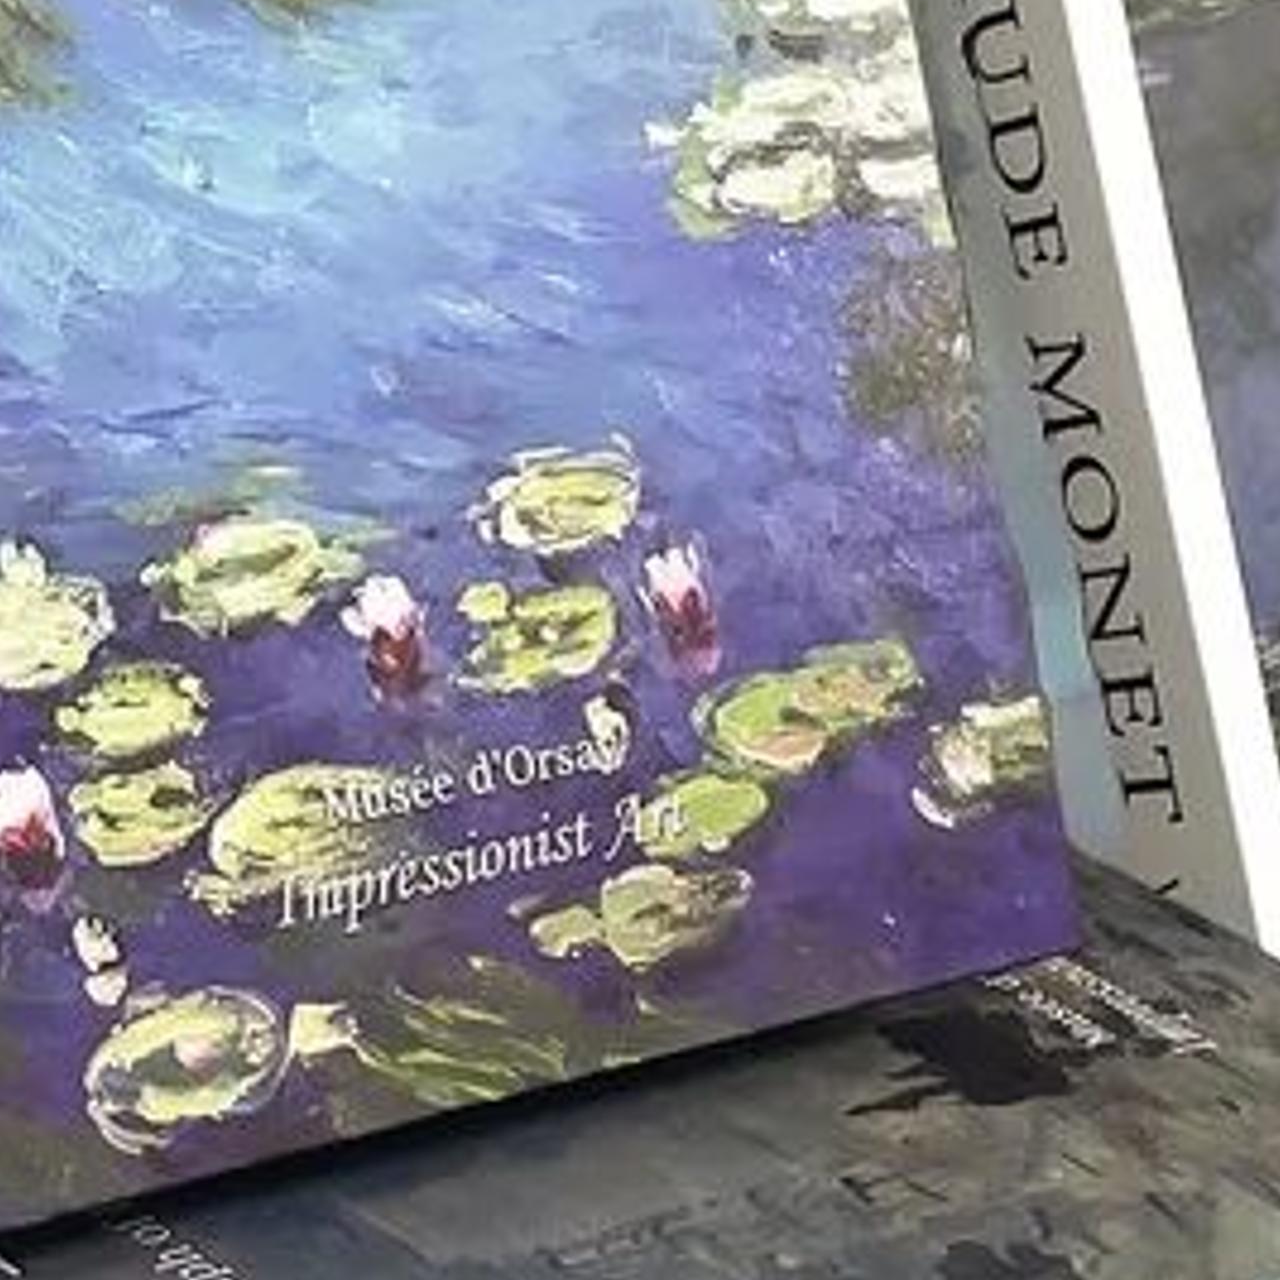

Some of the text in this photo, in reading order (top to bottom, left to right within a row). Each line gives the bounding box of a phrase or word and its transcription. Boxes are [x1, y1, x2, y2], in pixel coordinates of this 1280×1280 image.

[1026, 332, 1183, 828] MONET
[320, 760, 455, 830] Musée
[276, 810, 595, 933] Impressionist
